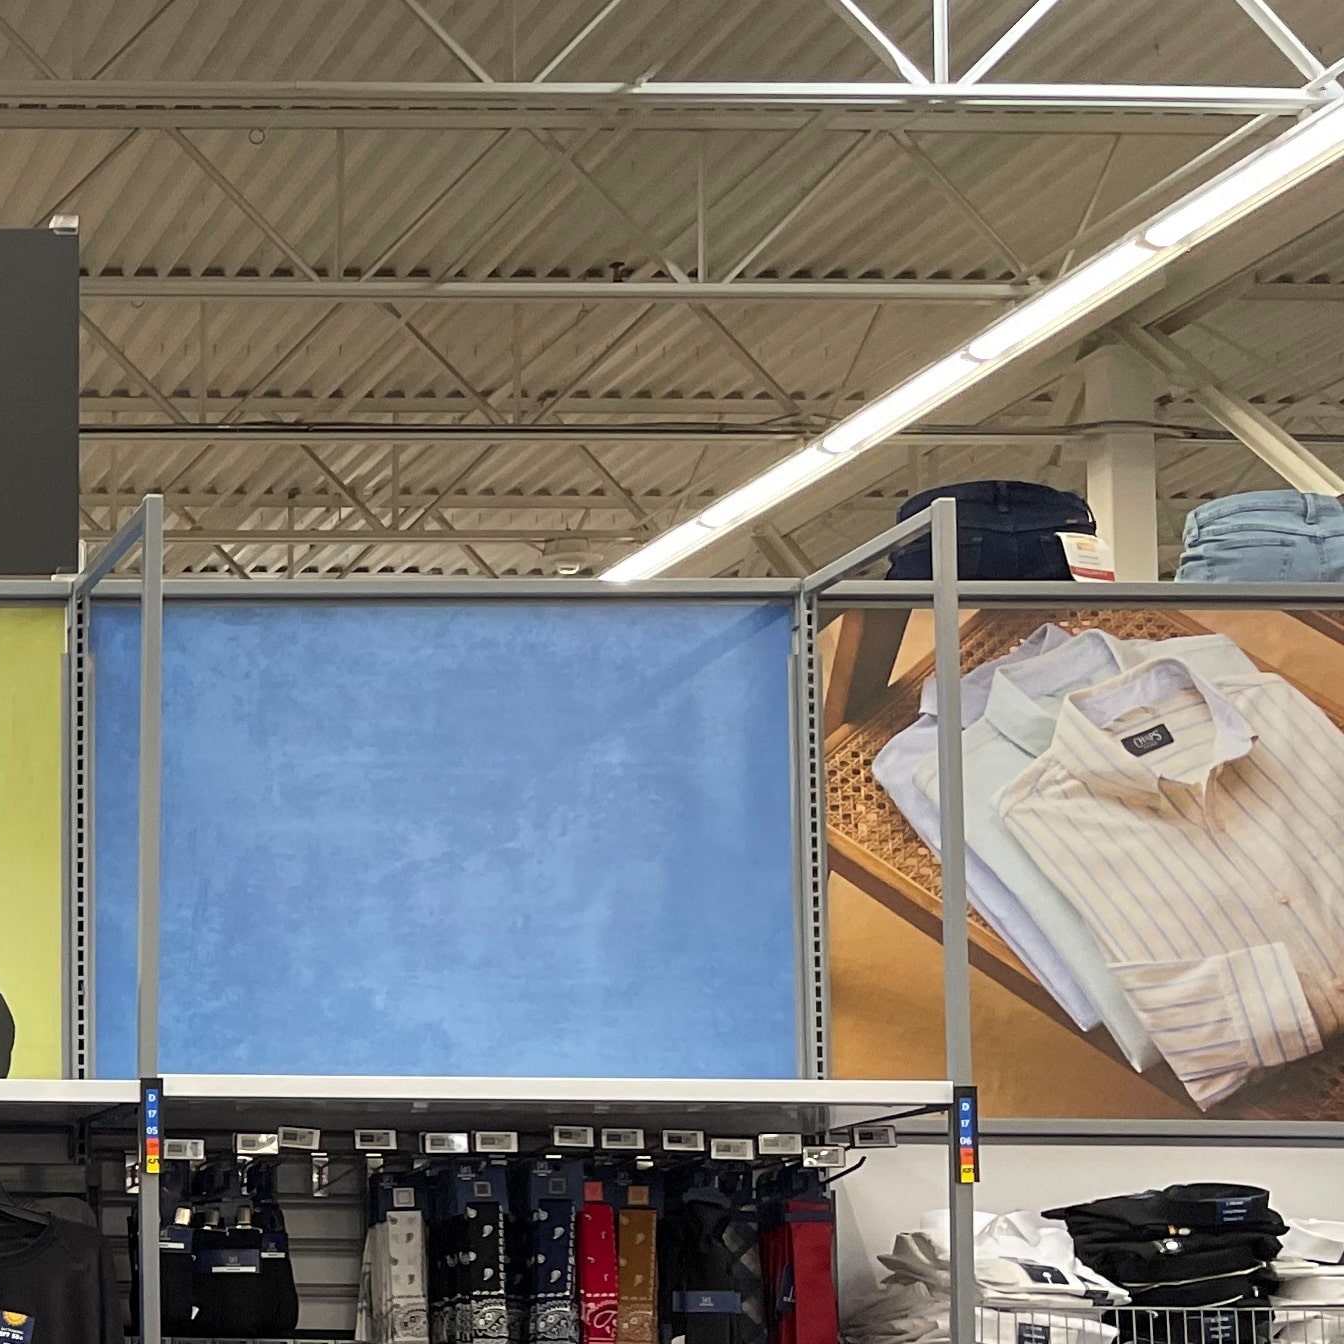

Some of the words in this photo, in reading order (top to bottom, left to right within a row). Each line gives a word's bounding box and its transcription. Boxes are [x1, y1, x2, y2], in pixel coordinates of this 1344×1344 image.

[148, 1093, 156, 1102] D
[961, 1102, 970, 1111] D
[148, 1110, 157, 1118] 17
[961, 1119, 970, 1128] 17
[146, 1126, 158, 1135] 05
[960, 1137, 972, 1145] 06
